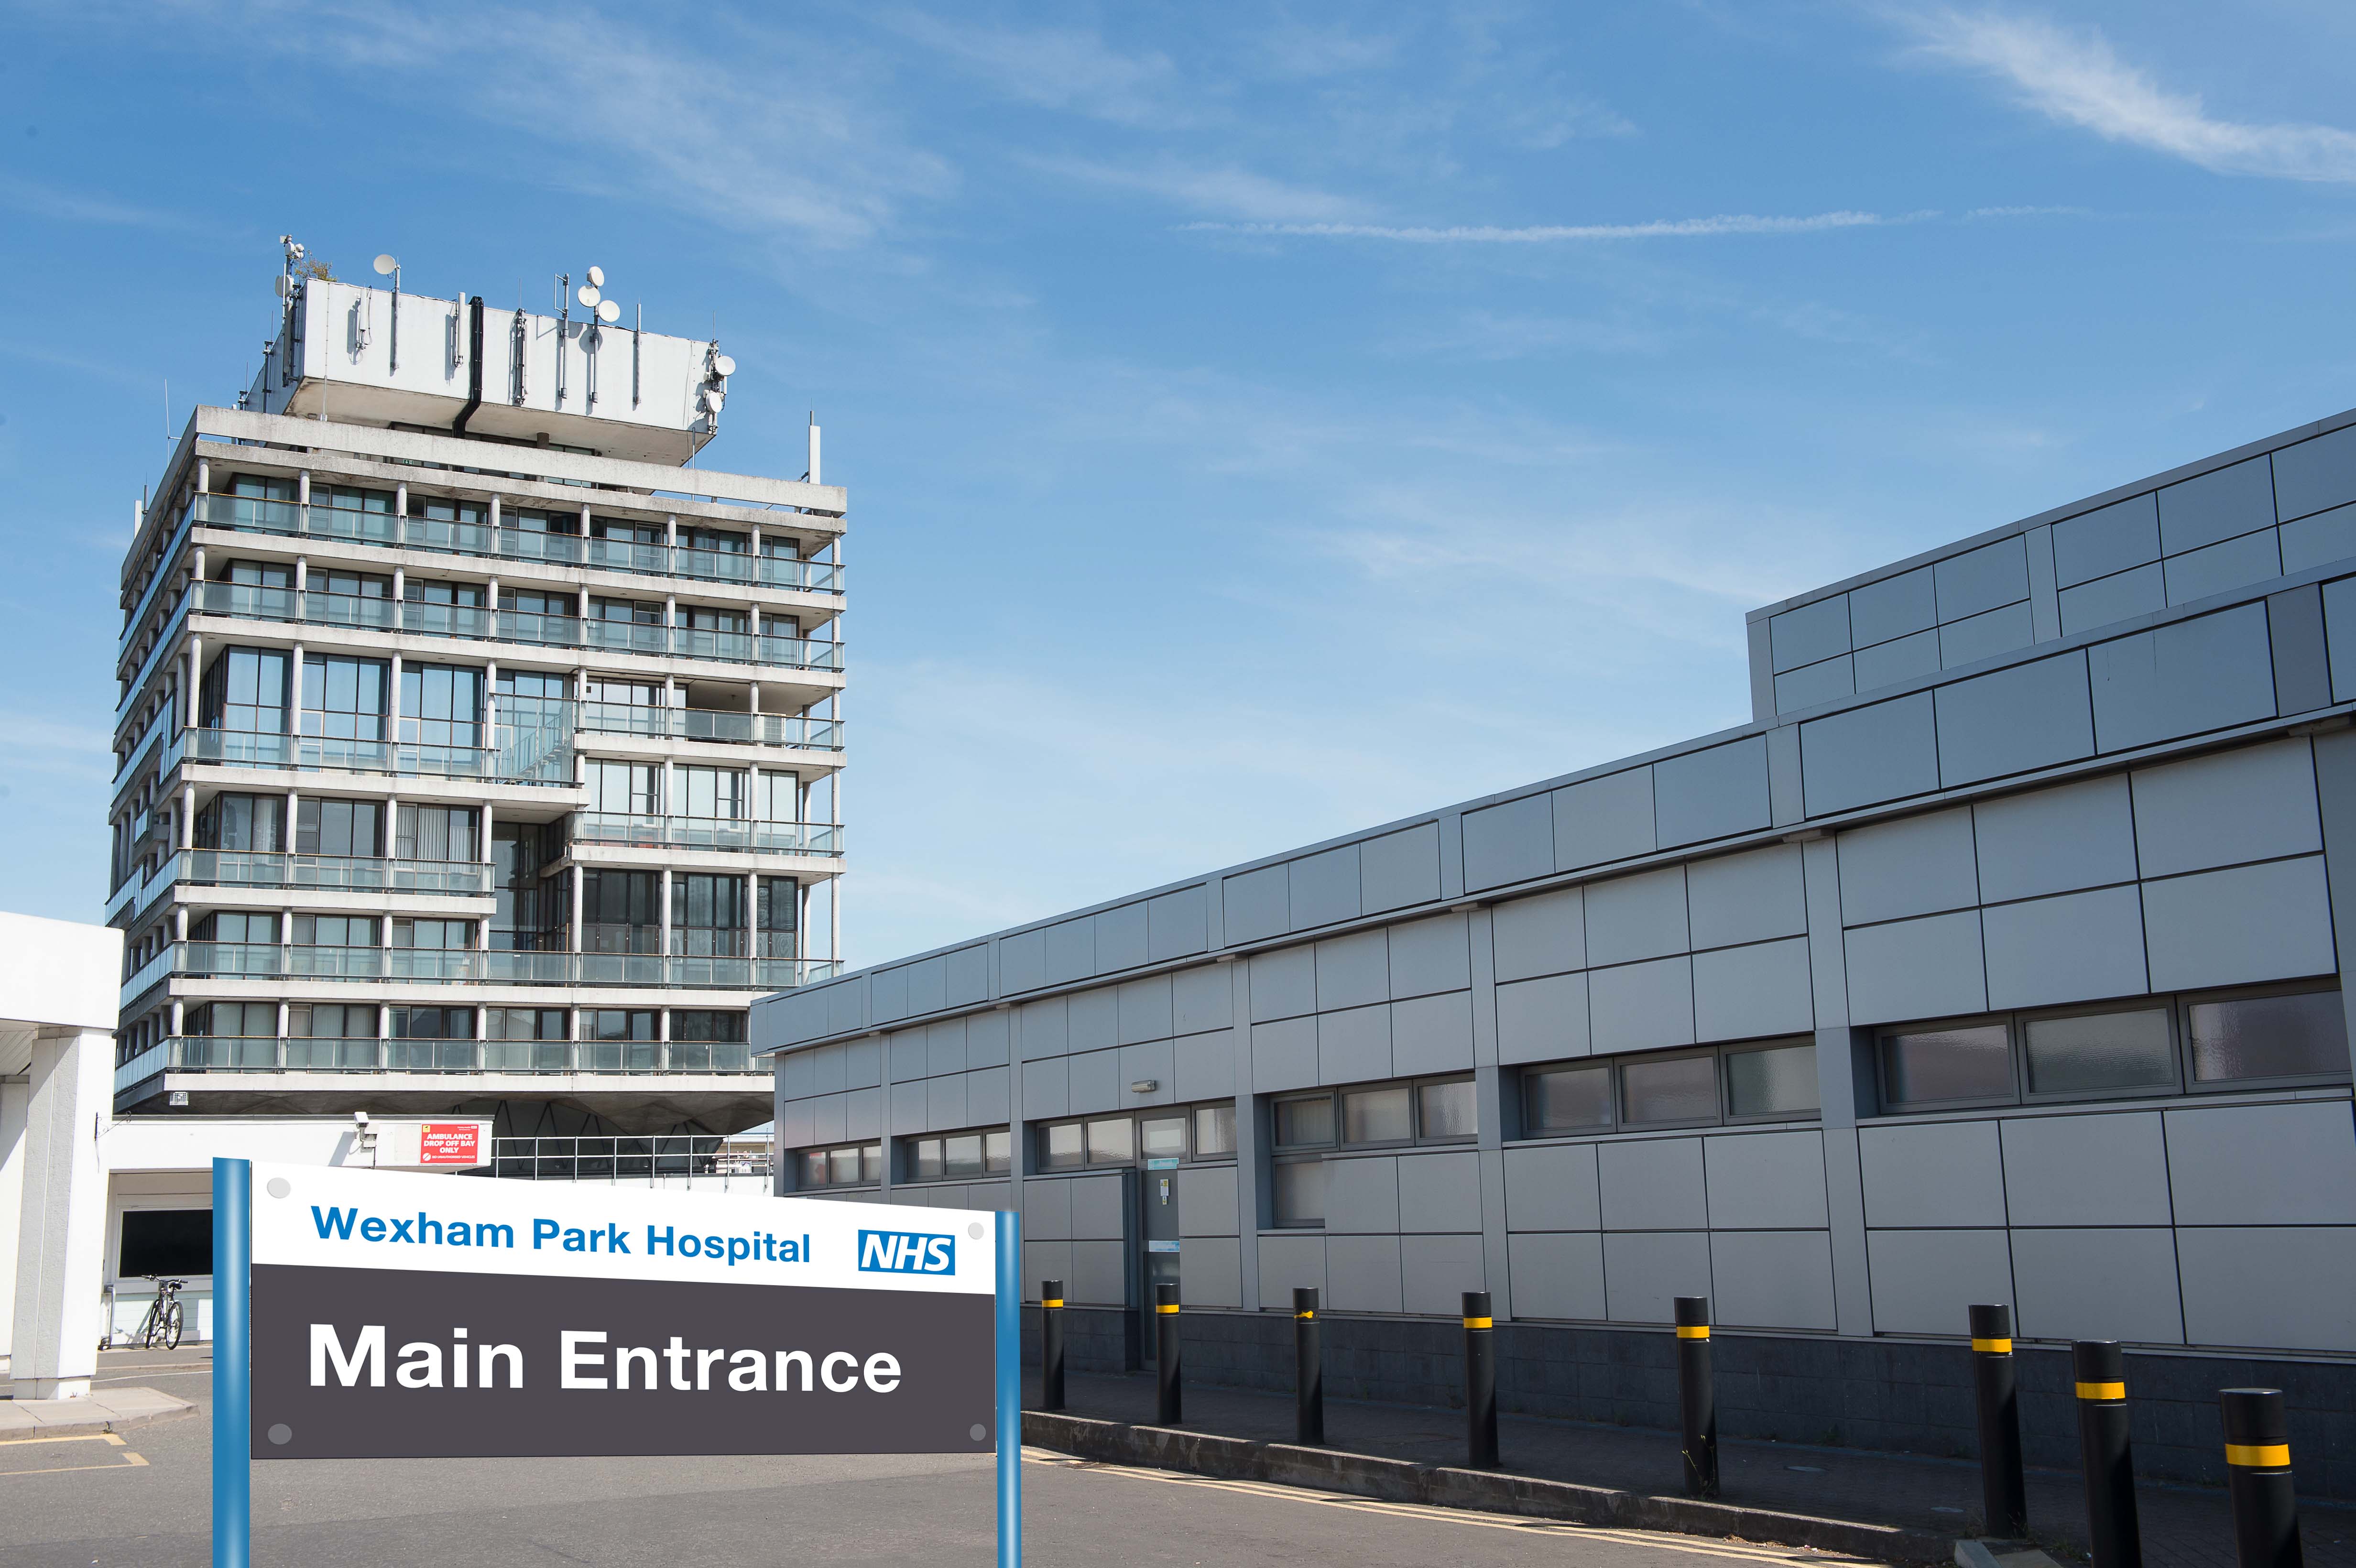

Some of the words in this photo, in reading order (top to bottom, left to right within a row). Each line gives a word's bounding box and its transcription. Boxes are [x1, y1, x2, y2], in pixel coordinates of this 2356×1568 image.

[311, 1206, 513, 1248] Wexham
[534, 1219, 631, 1254] Park
[648, 1225, 809, 1266] Hospital
[861, 1234, 952, 1272] NHS
[311, 1324, 523, 1388] Main
[561, 1330, 901, 1393] Entrance
